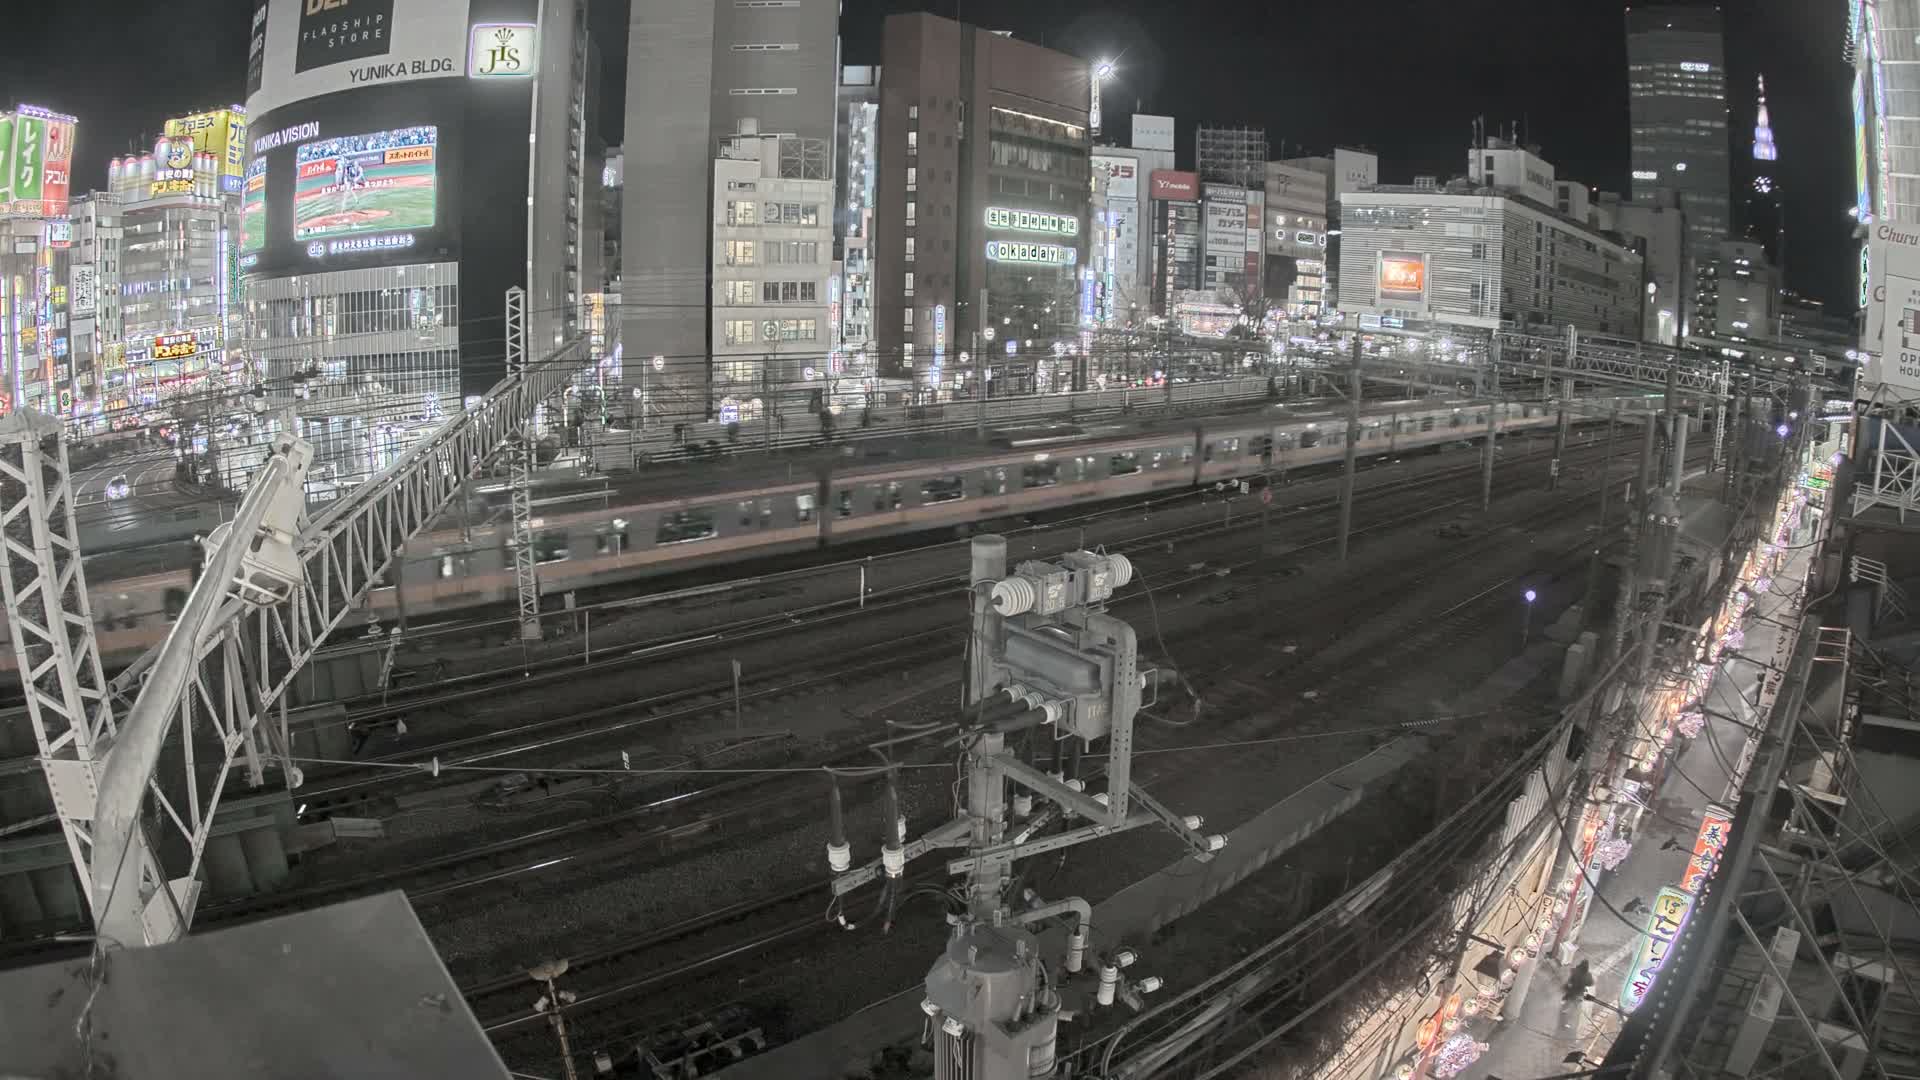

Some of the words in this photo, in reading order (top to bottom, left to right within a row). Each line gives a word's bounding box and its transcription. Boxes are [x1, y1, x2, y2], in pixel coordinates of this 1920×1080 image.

[303, 14, 383, 41] FLAGSHIP
[328, 29, 382, 48] STORE
[349, 62, 408, 83] YUNIKA
[411, 58, 456, 75] BLDG.
[255, 131, 281, 154] YUNIKA
[281, 120, 320, 145] VISION
[21, 120, 37, 188] レイク
[45, 170, 69, 185] アコム
[1878, 225, 1919, 246] Churu
[1000, 244, 1065, 263] okadaya
